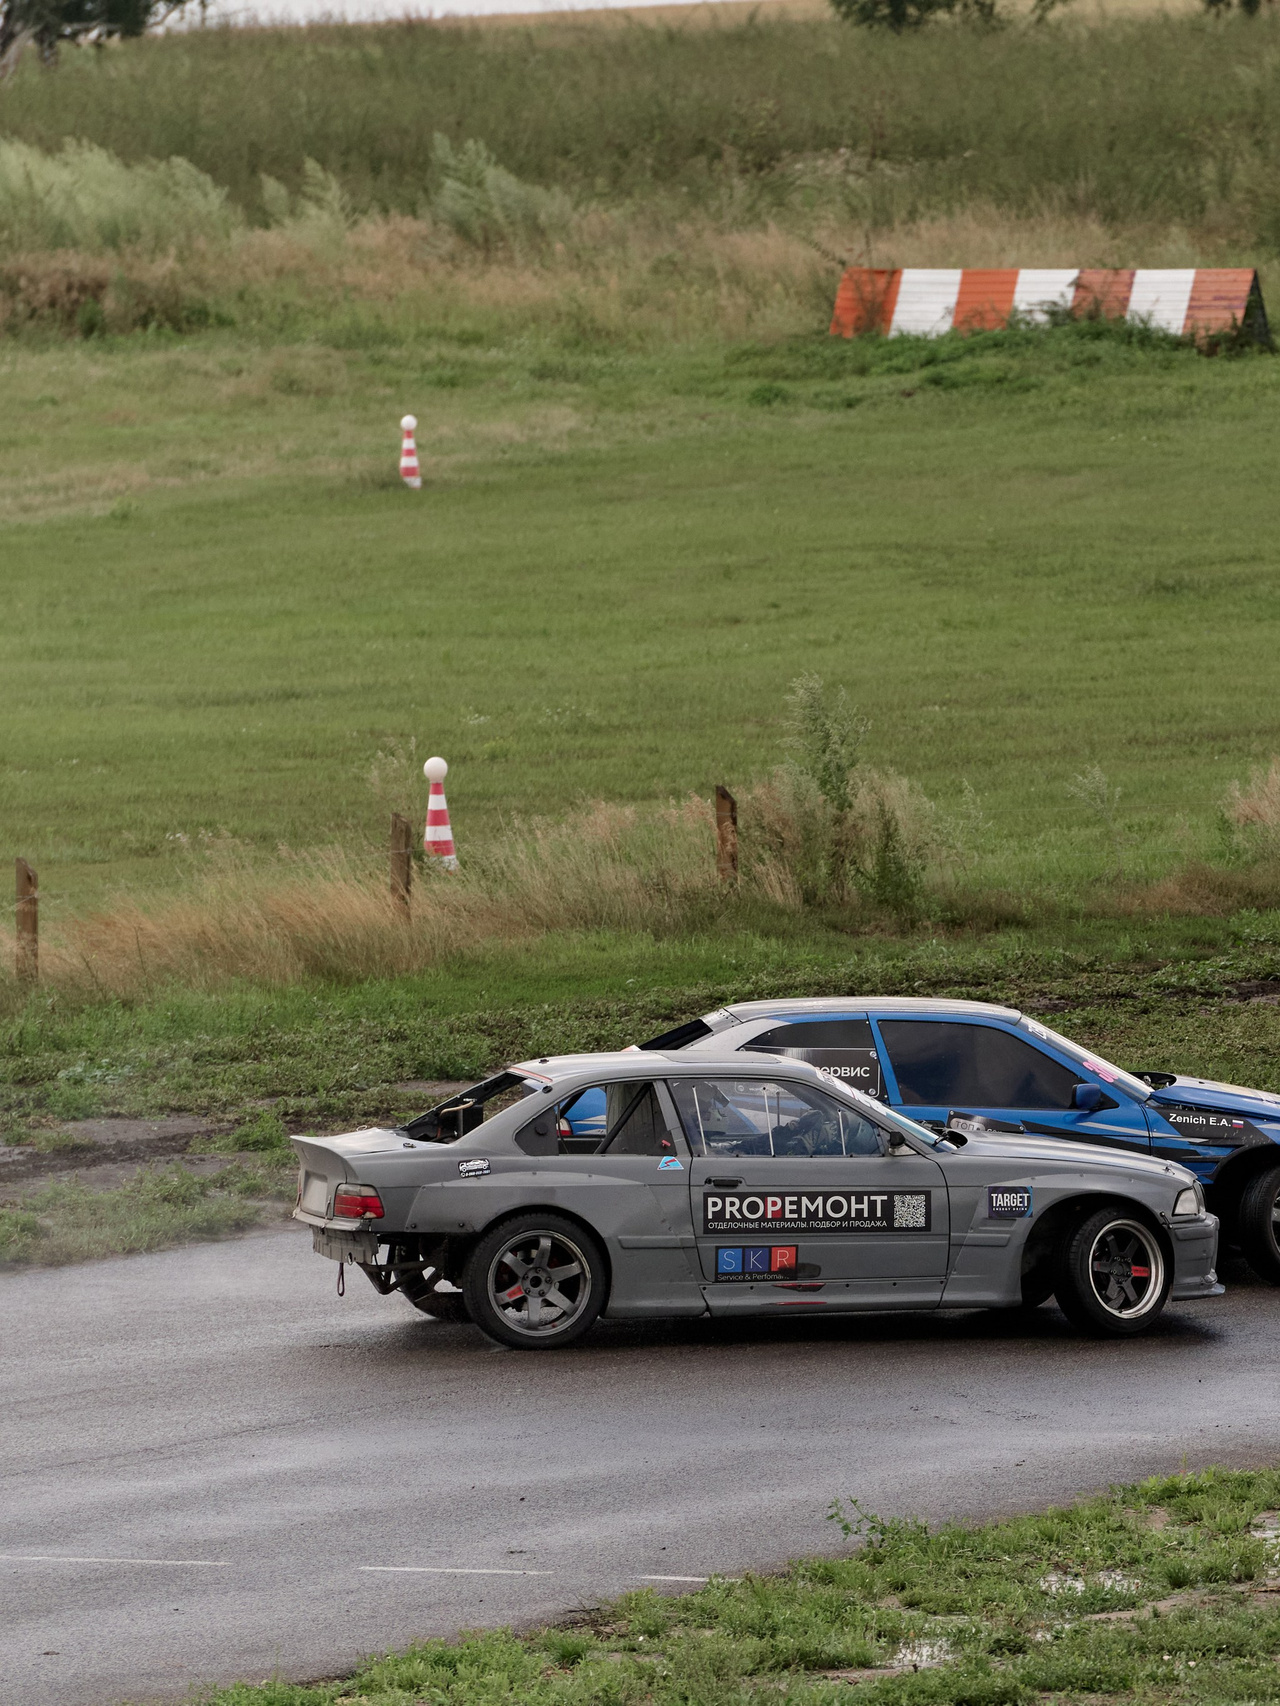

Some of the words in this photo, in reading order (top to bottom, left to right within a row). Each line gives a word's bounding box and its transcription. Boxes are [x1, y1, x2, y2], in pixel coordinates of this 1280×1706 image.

[815, 1066, 870, 1078] ервис
[1168, 1113, 1206, 1125] Zenich
[1209, 1117, 1232, 1127] E.A.
[990, 1193, 1031, 1207] TARGET
[708, 1221, 759, 1230] ОТДЕЛОЧНЫЕ
[760, 1220, 809, 1229] МАТЕРИАЛЫ.
[809, 1220, 840, 1229] ПОДБОР
[842, 1220, 848, 1228] И
[849, 1220, 888, 1228] ПРОДАЖА
[717, 1273, 744, 1281] Service
